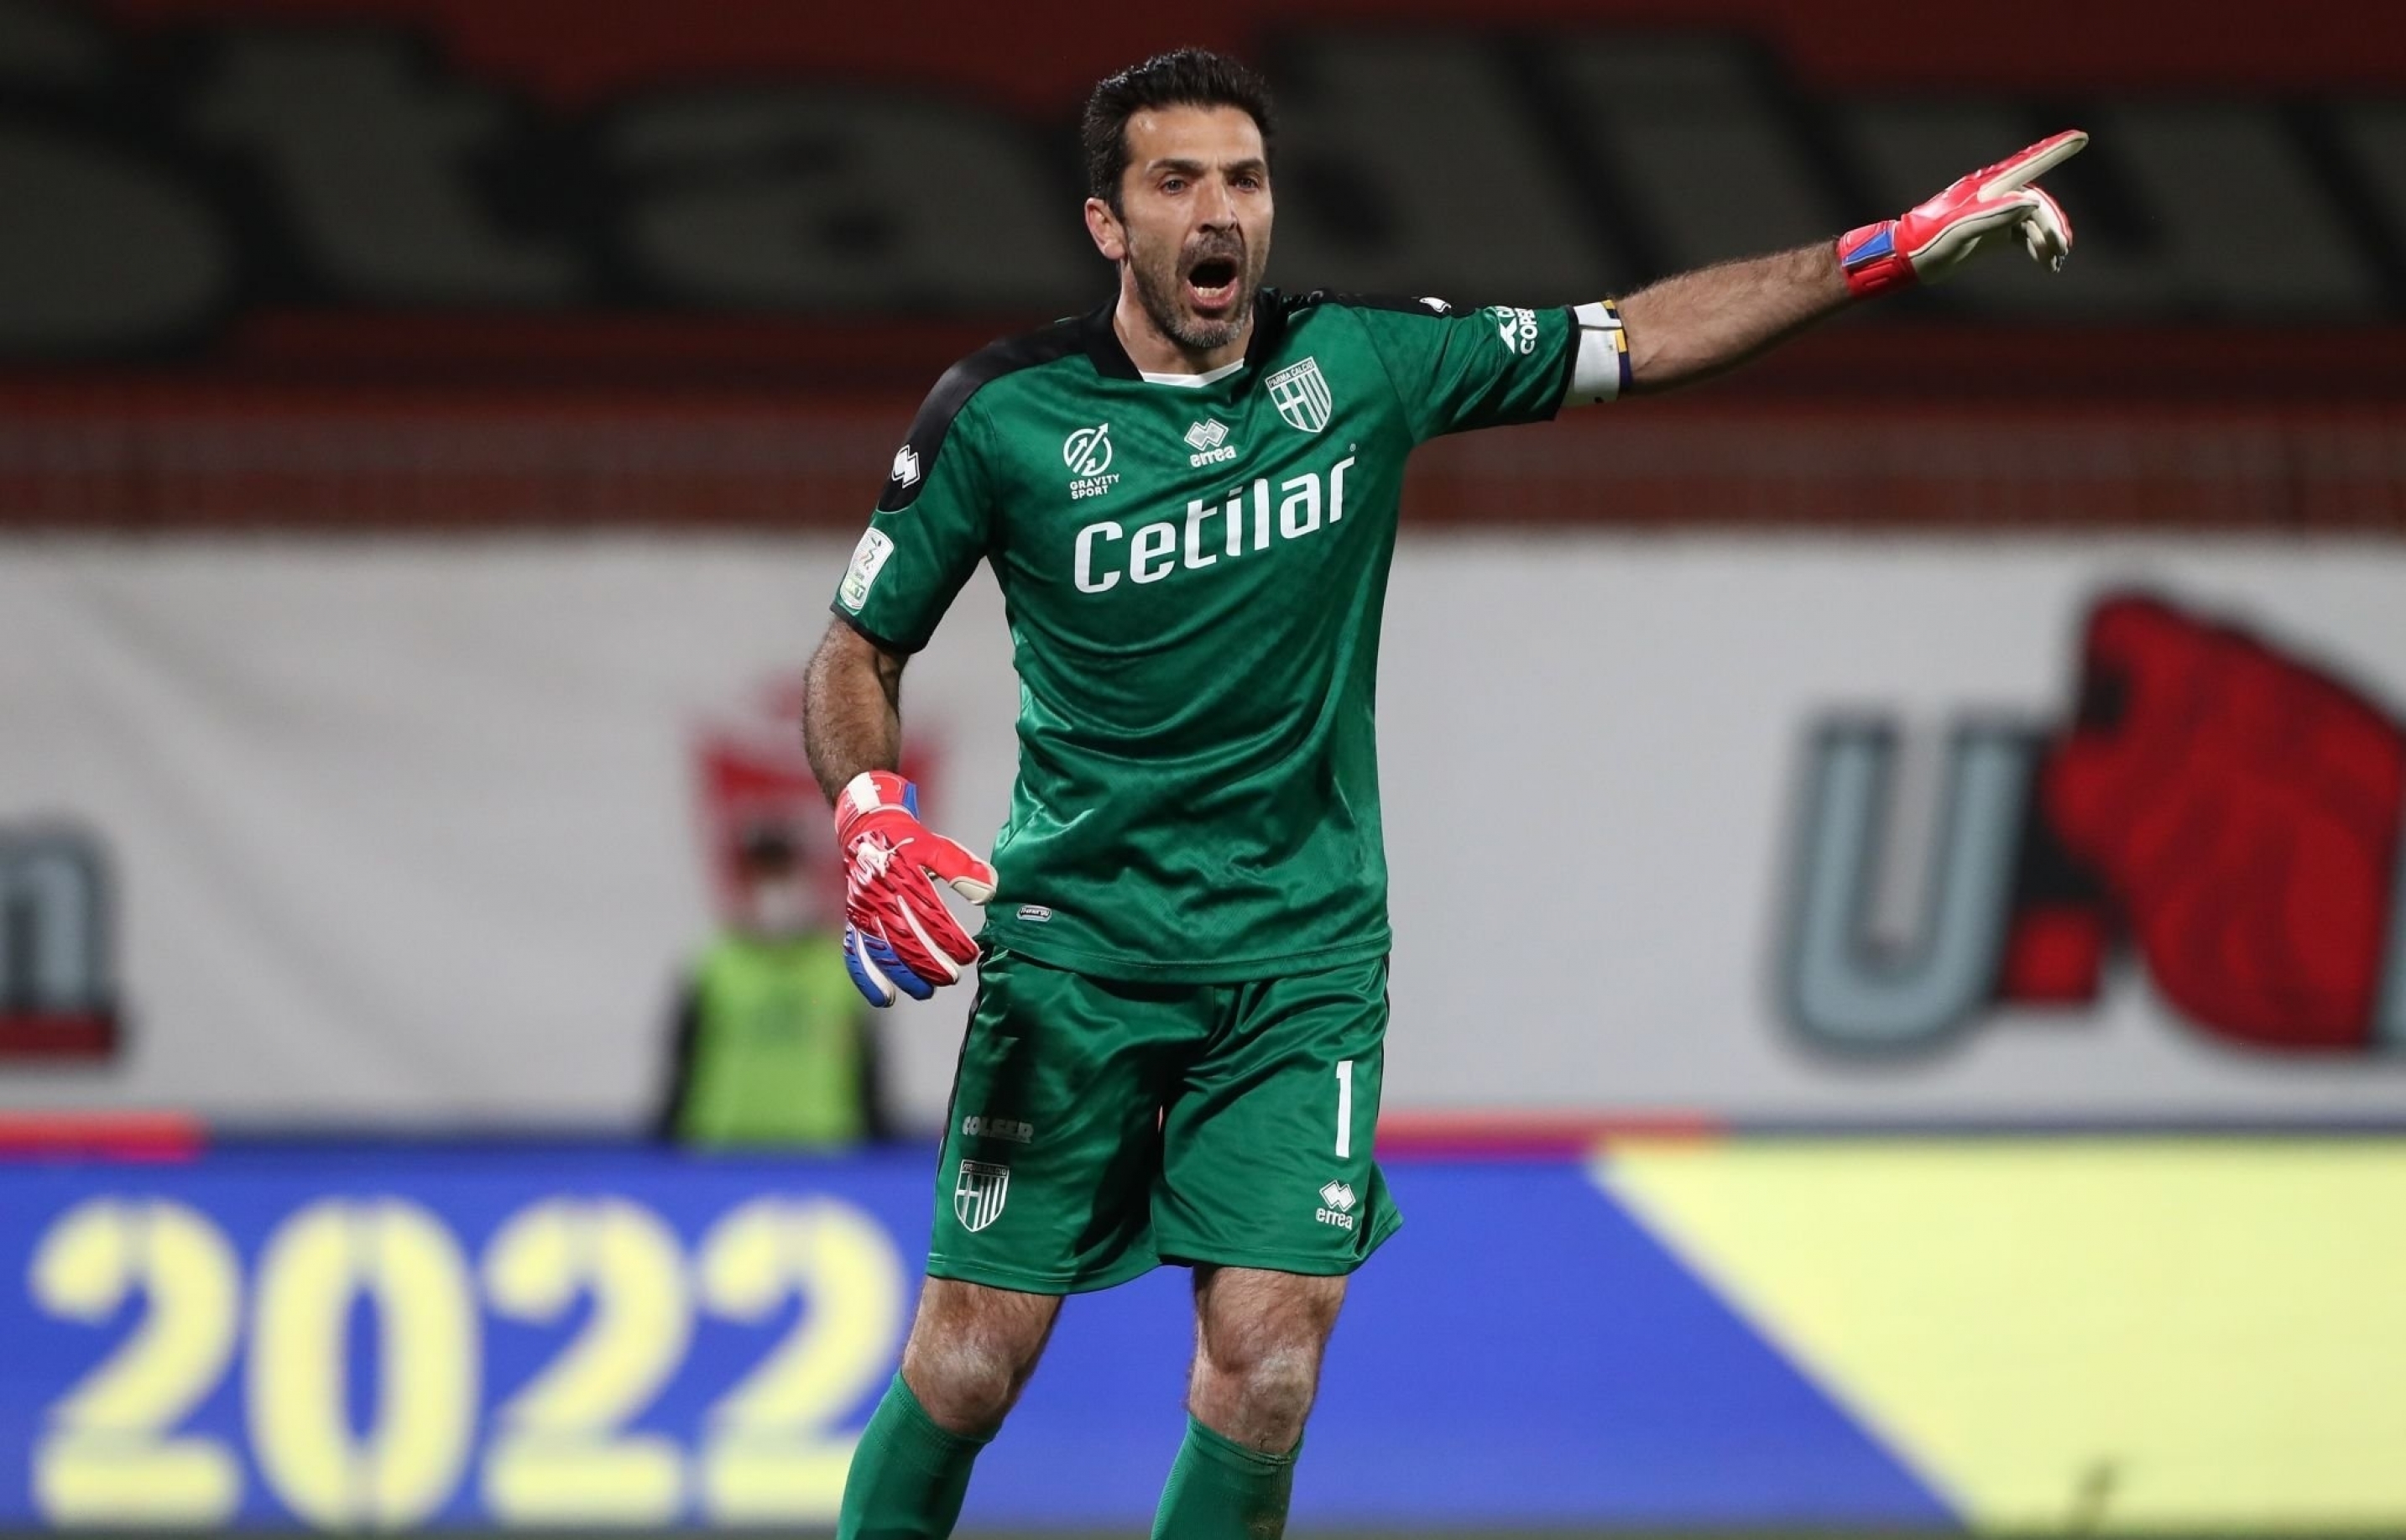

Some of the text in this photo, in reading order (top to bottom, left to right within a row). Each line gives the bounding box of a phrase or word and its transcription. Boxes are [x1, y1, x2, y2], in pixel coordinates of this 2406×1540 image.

[1069, 473, 1119, 491] GRAVITY
[1071, 484, 1109, 500] SPORT
[1074, 455, 1355, 593] Cetilar
[1335, 1060, 1354, 1159] 1
[1315, 1207, 1353, 1230] errea
[32, 1196, 908, 1534] 2022
